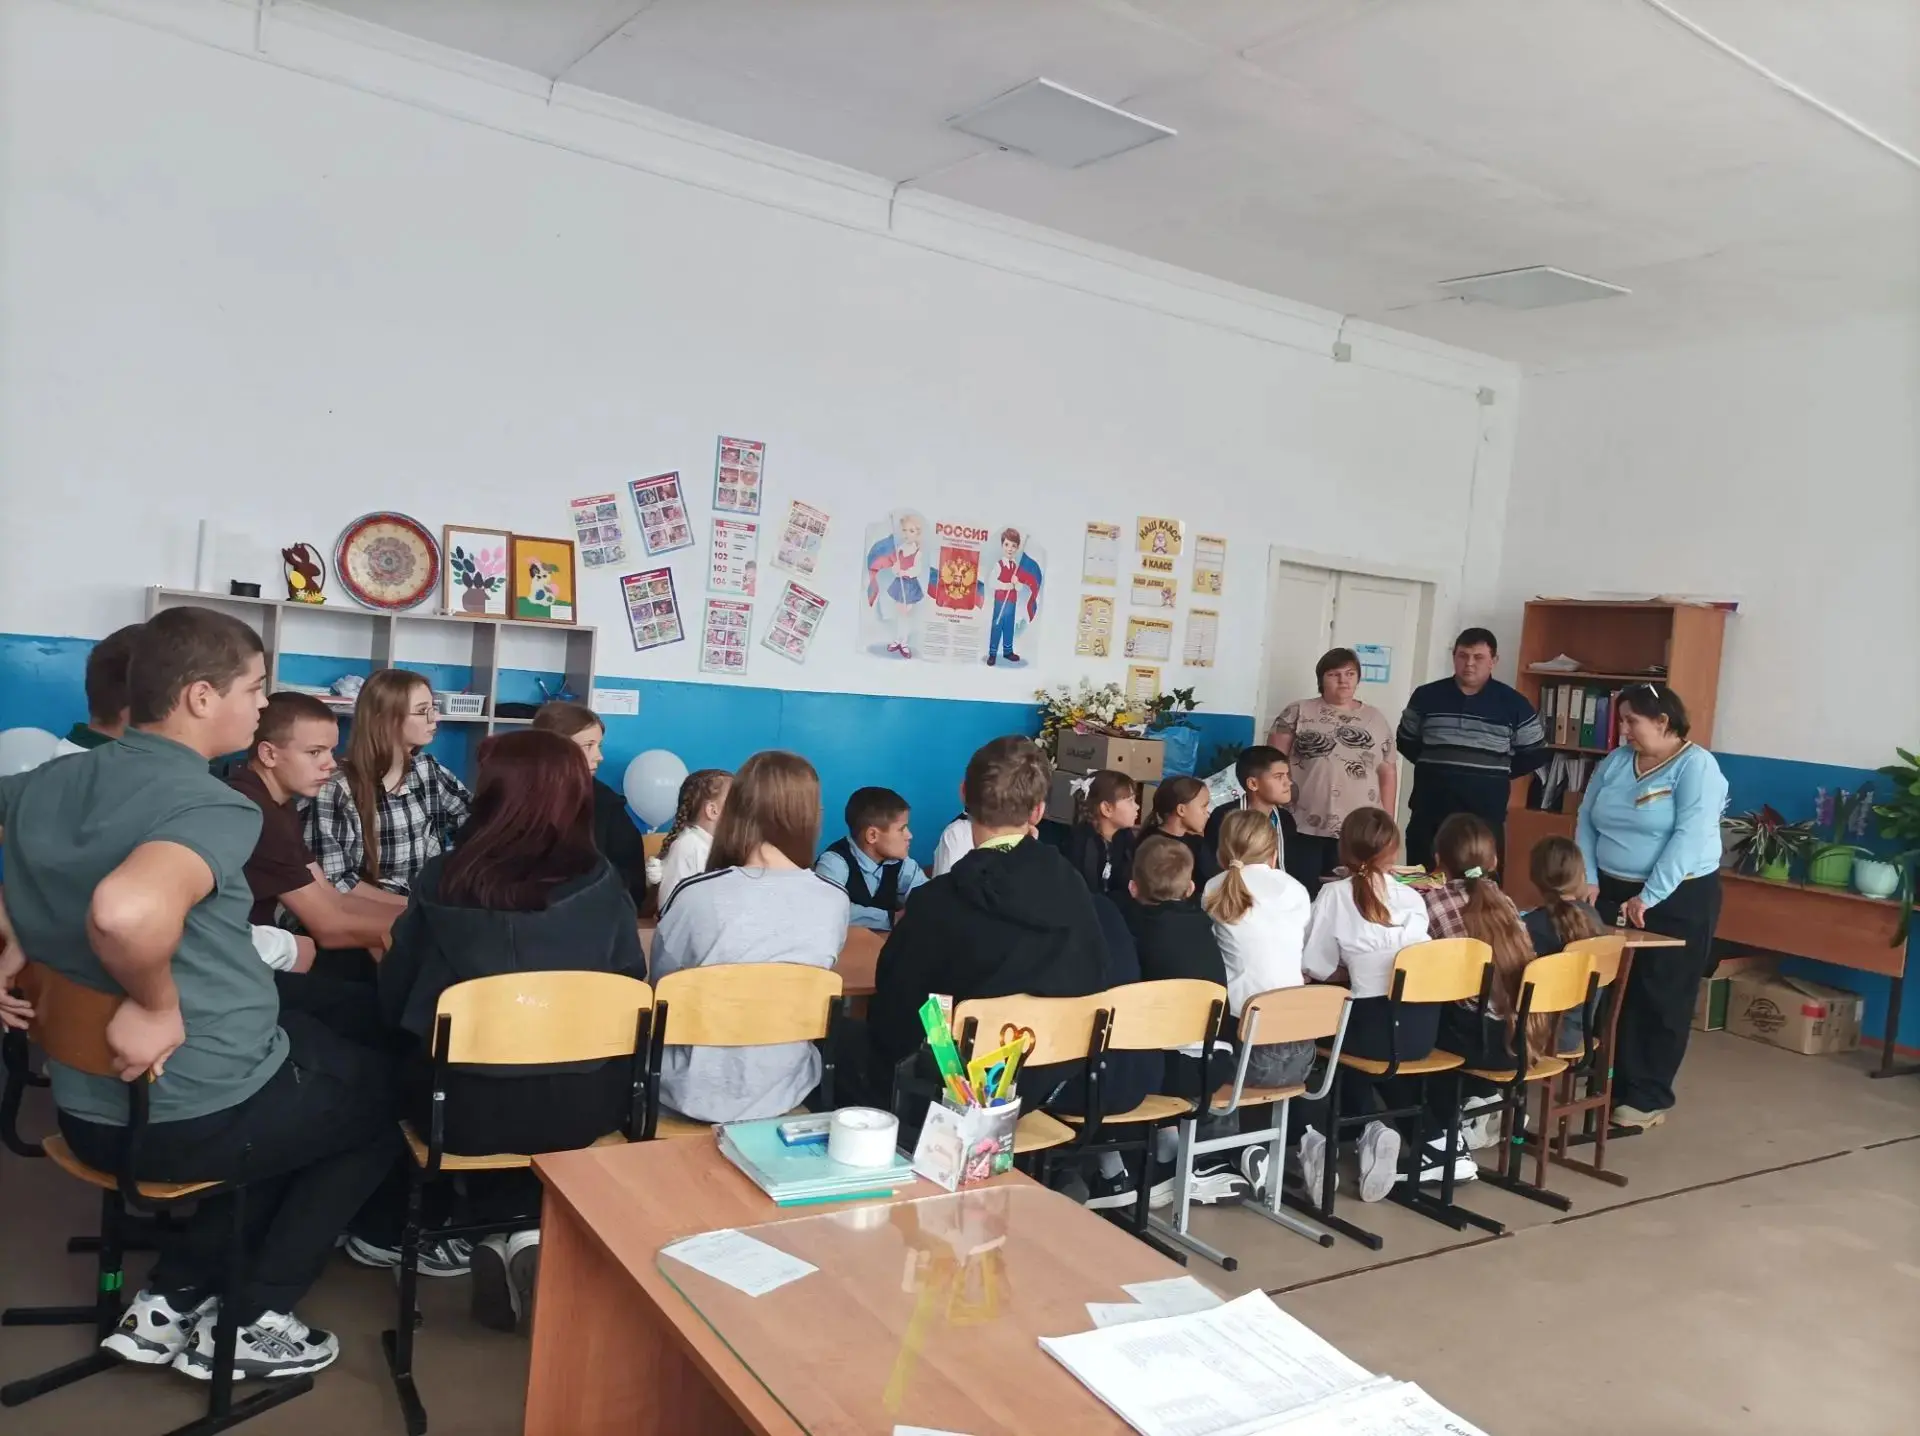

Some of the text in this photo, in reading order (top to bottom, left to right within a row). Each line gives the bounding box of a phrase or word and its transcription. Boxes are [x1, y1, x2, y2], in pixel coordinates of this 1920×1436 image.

[935, 522, 989, 542] РОССИЯ
[1139, 520, 1182, 542] НАШ КЛАСС
[714, 541, 727, 549] 101
[714, 552, 728, 560] 102
[713, 564, 728, 573] 103
[1149, 559, 1173, 571] КЛАСС
